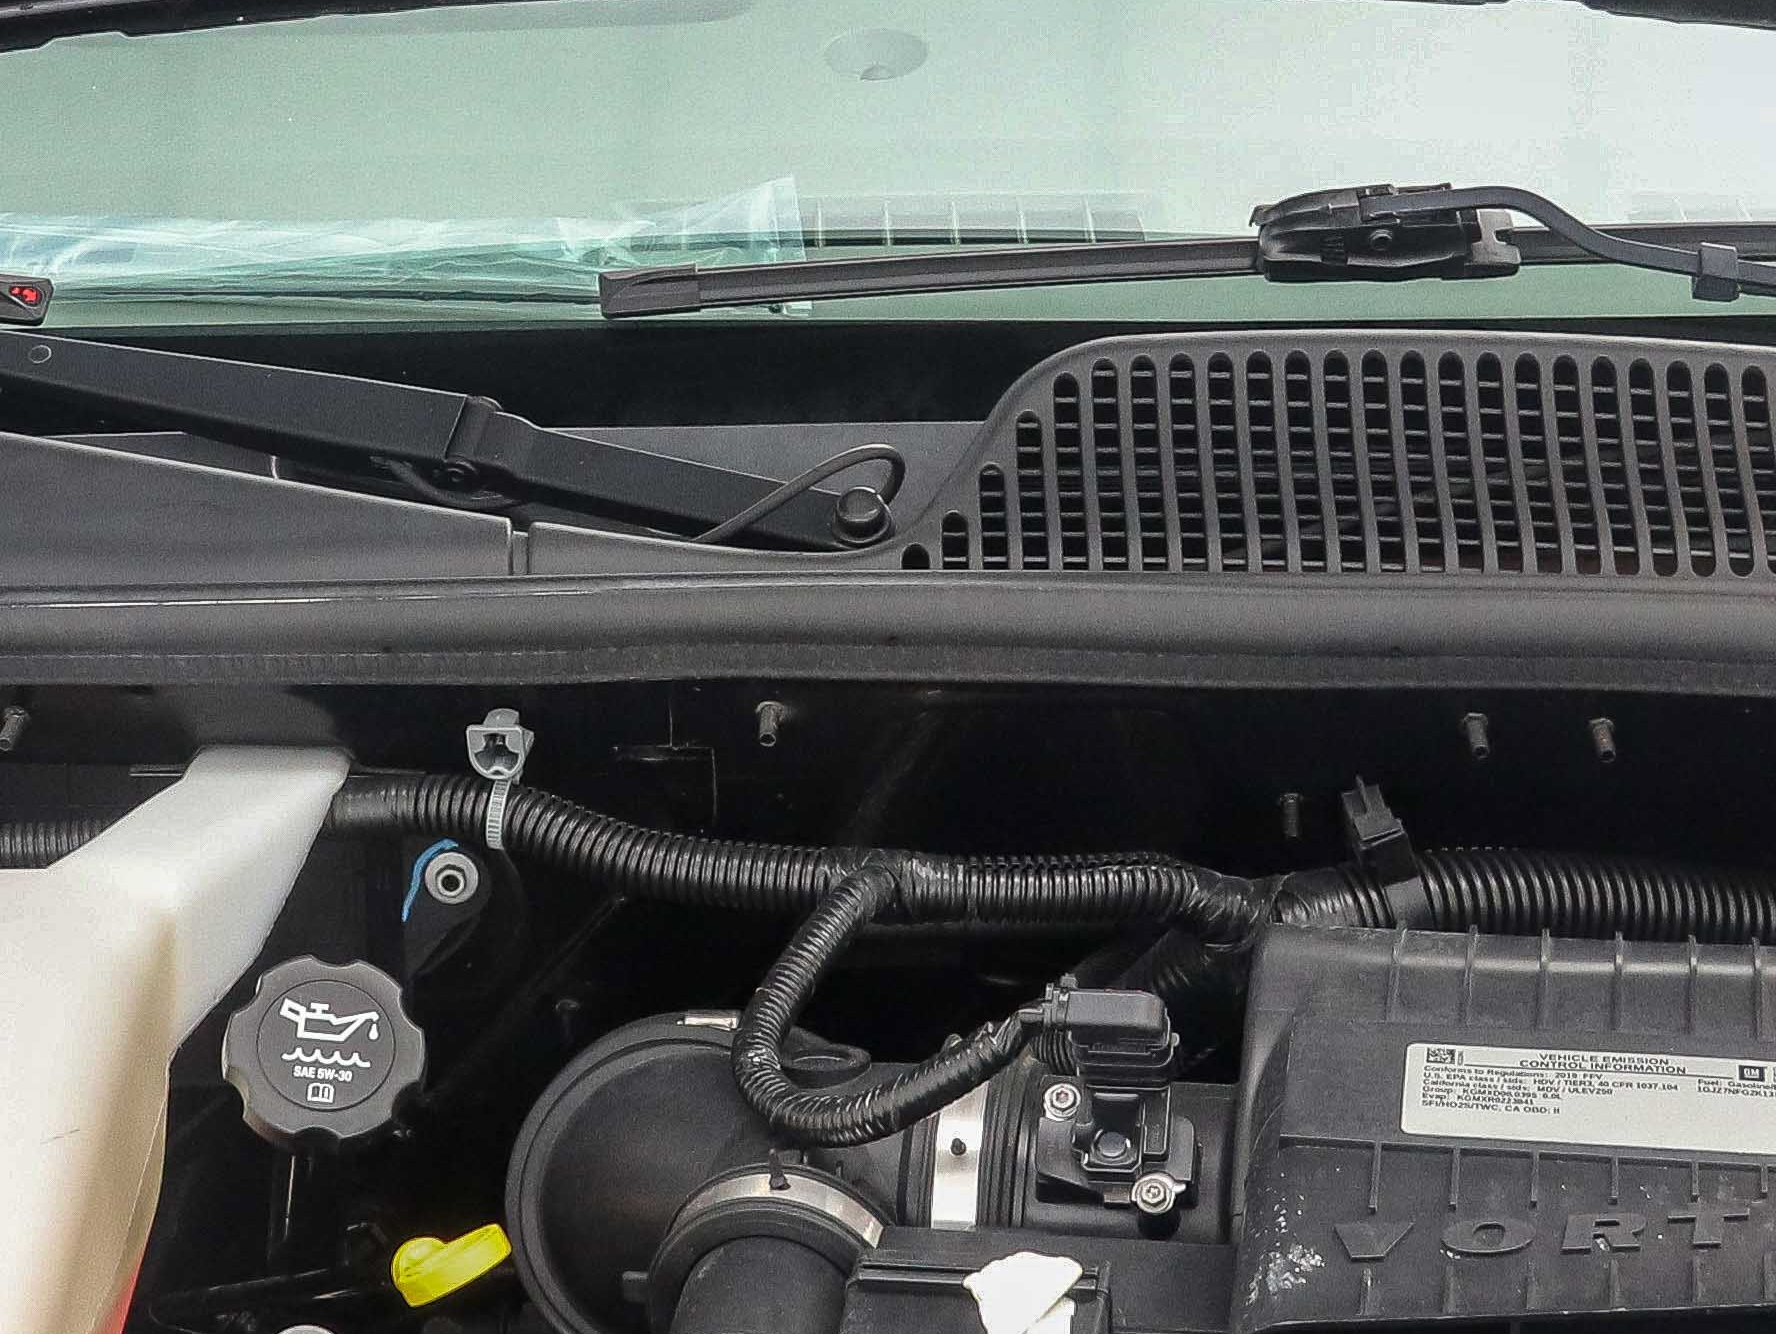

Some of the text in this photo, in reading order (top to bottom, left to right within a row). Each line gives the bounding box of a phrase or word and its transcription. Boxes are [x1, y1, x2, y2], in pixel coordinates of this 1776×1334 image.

[1539, 1053, 1669, 1065] VEHICLE EMISSION
[1424, 1066, 1472, 1074] Conforms
[1519, 1059, 1687, 1074] CONTROL INFORMATION
[1743, 1067, 1760, 1078] GM
[293, 1065, 353, 1082] SAE 5W-30
